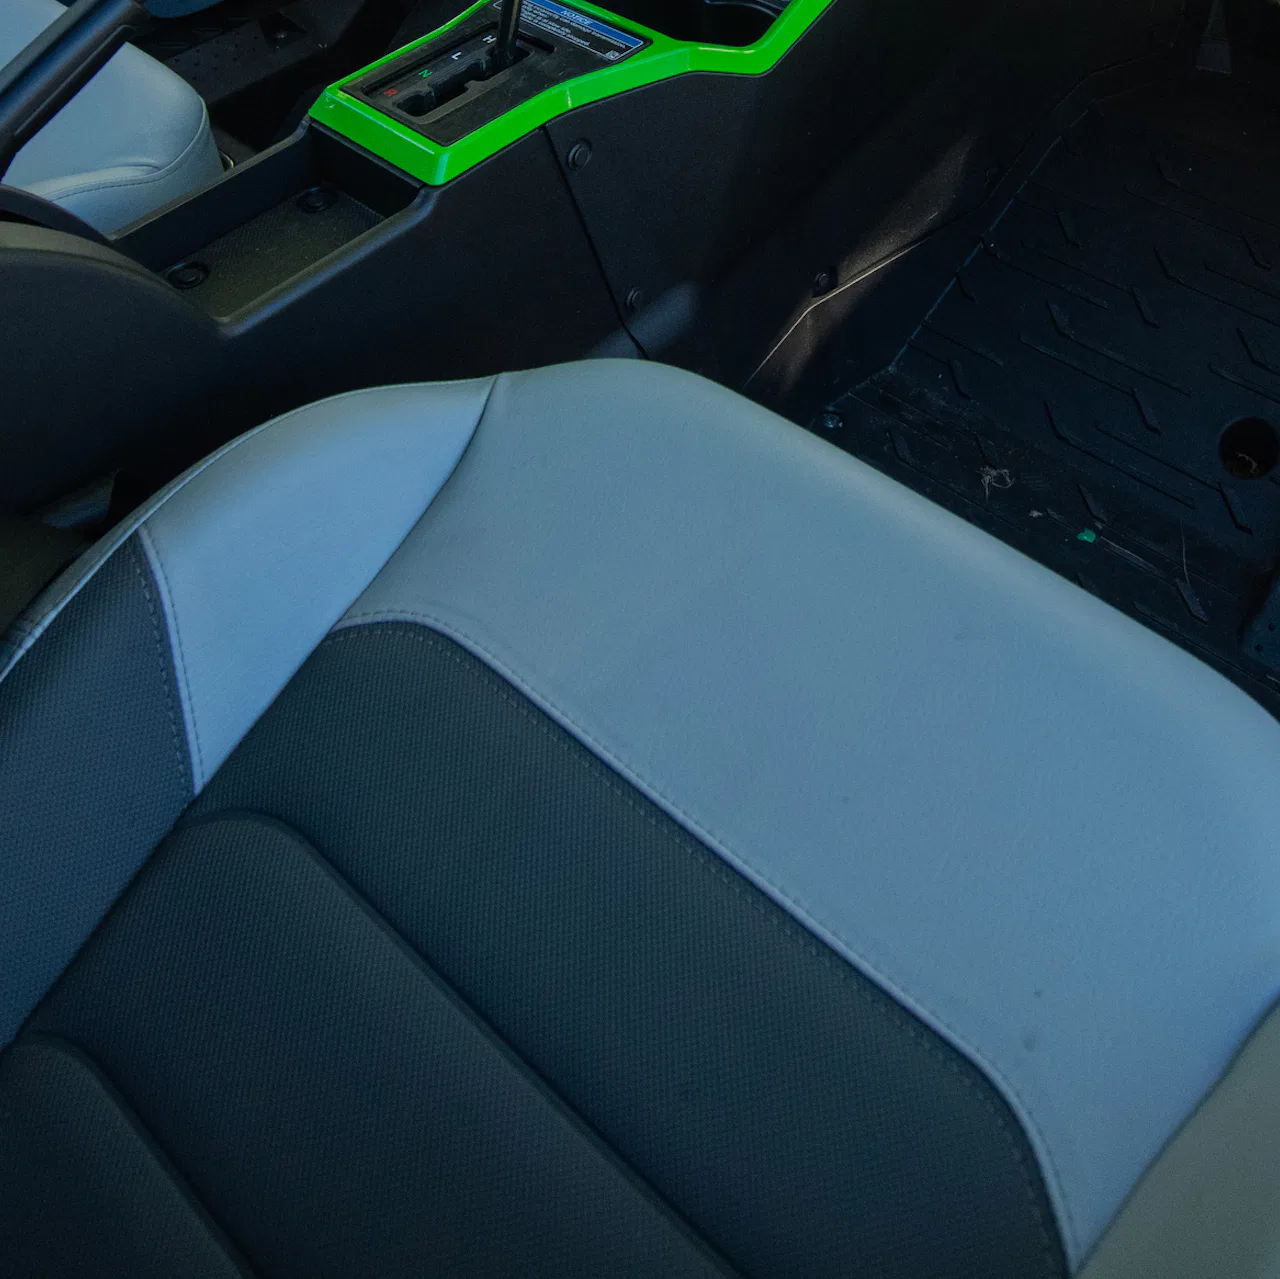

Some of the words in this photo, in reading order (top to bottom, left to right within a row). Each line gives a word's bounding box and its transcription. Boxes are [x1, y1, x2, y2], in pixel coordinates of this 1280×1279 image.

[560, 9, 593, 26] NOTICE
[482, 35, 497, 44] H
[451, 51, 462, 60] L
[418, 69, 433, 78] N
[383, 88, 397, 97] R
